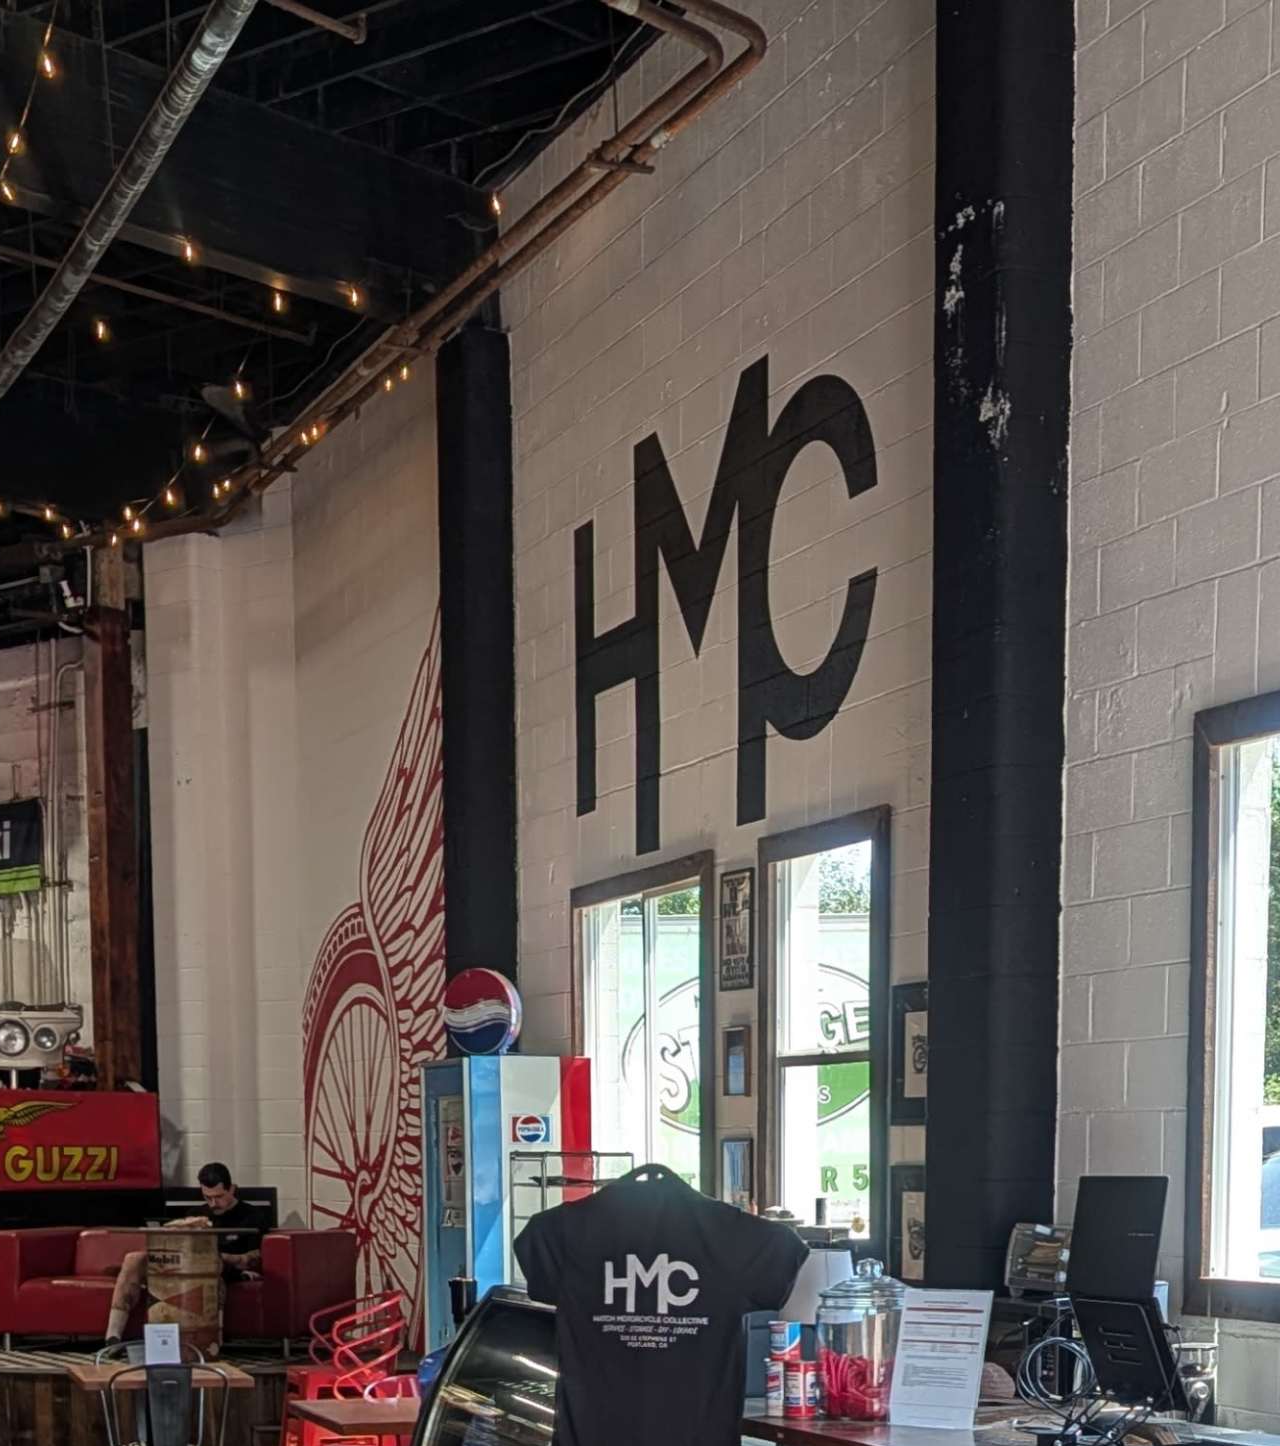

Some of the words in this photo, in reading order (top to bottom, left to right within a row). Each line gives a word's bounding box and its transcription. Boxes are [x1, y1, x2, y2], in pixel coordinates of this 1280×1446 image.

[573, 352, 878, 857] HMC
[4, 1145, 119, 1183] GUZZI
[603, 1252, 700, 1314] HMC
[662, 1316, 709, 1326] COLLECTIVE
